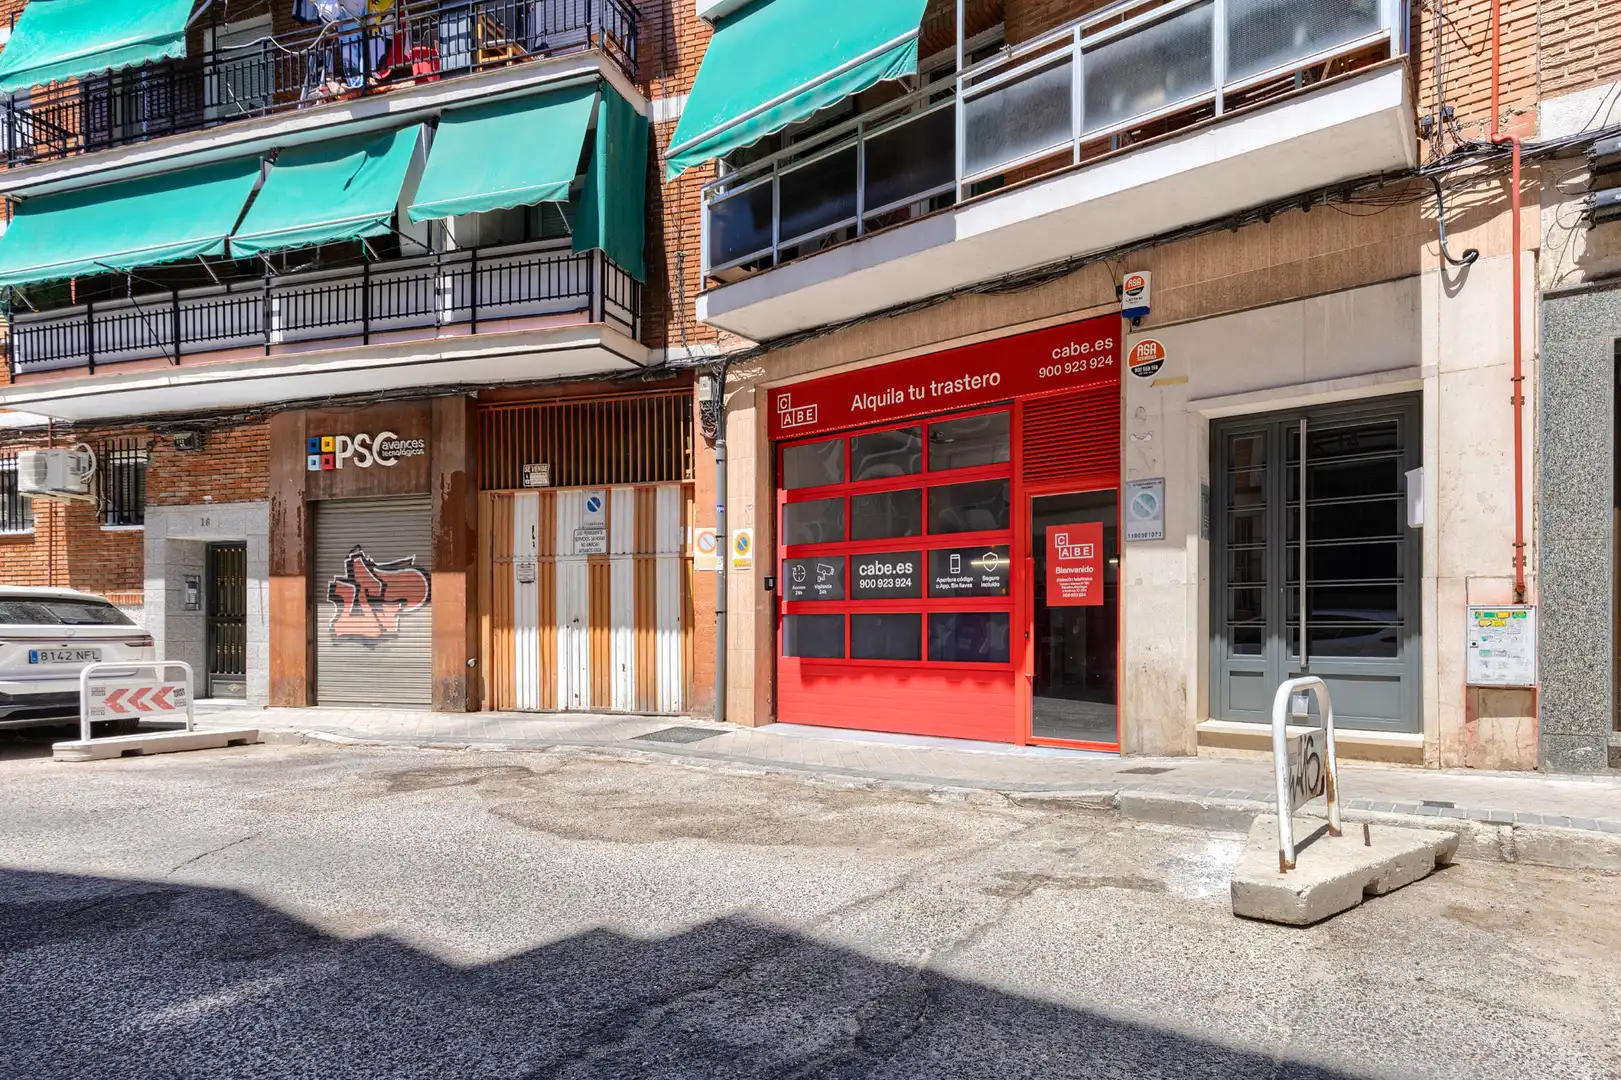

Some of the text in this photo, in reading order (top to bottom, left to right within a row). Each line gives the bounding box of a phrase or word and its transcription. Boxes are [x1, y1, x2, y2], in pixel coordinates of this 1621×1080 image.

[1128, 278, 1142, 288] ASA
[1052, 337, 1113, 359] cabe.es
[1137, 342, 1156, 356] ASA
[1039, 355, 1113, 378] 900 923 924
[851, 372, 1001, 412] Alquila tu trastero
[336, 431, 398, 469] PSC
[382, 439, 425, 450] avances
[200, 517, 210, 526] 16
[859, 560, 913, 575] cabe.es
[1056, 566, 1094, 574] Bienvenido
[860, 578, 912, 588] 900 923 924
[41, 651, 99, 660] 8142 NFL
